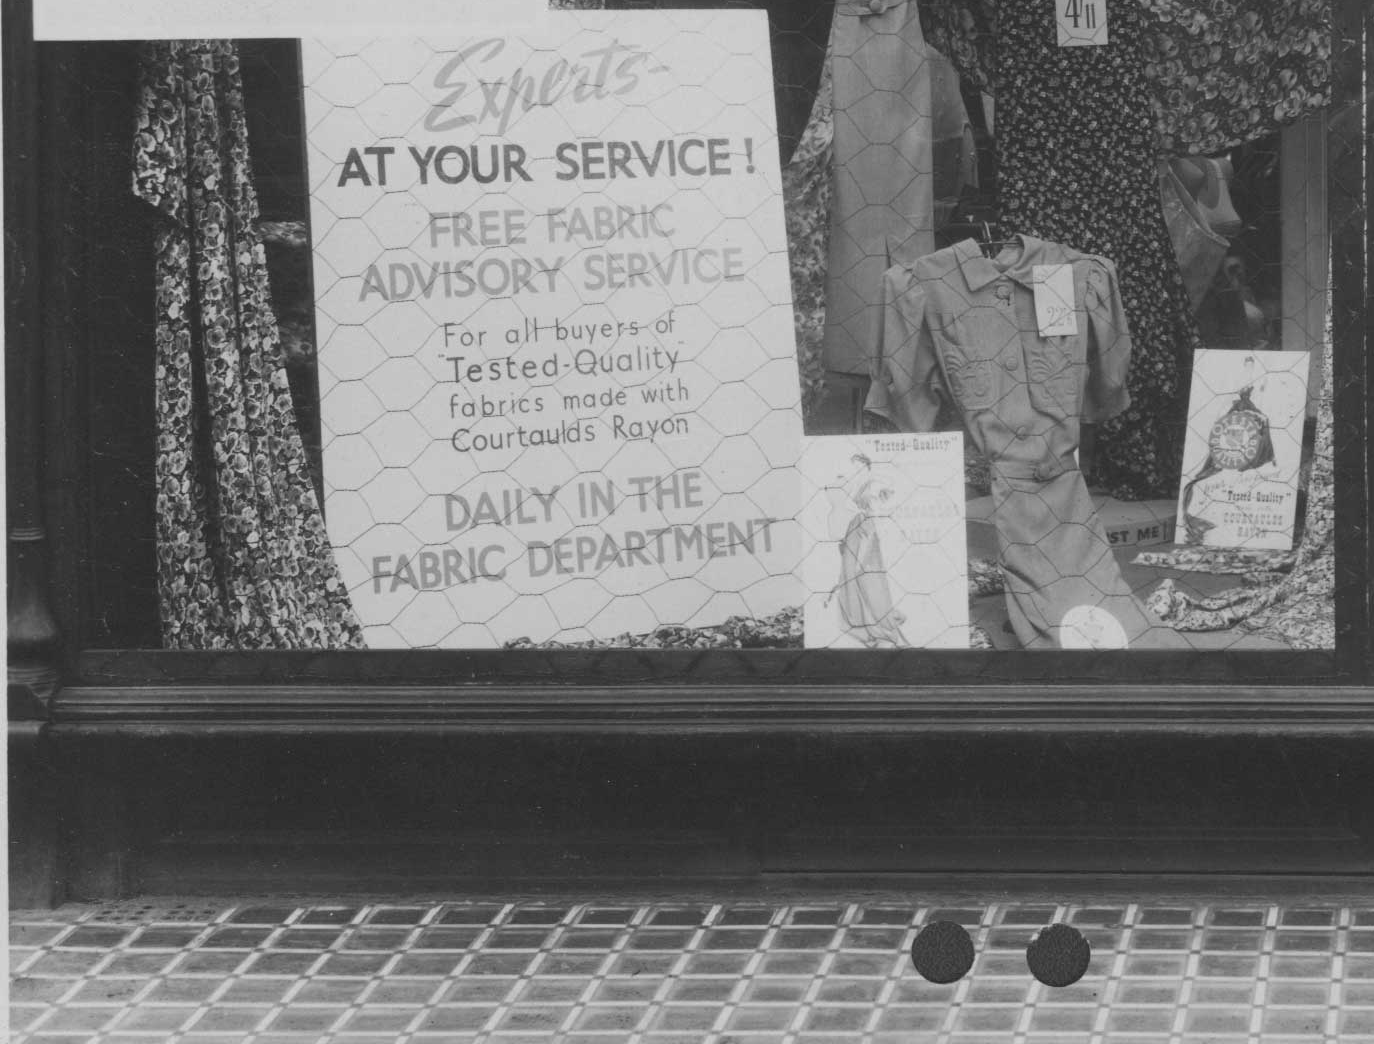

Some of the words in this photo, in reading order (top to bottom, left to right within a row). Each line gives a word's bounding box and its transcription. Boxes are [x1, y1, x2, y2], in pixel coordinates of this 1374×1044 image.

[336, 145, 396, 187] AT
[407, 143, 534, 185] YOUR
[428, 208, 528, 249] FREE
[545, 203, 677, 244] FABRIC
[357, 255, 566, 303] ADVISORY
[583, 246, 746, 292] SERVICE
[443, 322, 488, 348] For
[504, 318, 539, 345] all
[555, 317, 640, 345] buyers
[655, 309, 677, 335] of
[449, 392, 545, 420] fabrics
[562, 386, 628, 412] made
[641, 377, 690, 404] with
[450, 419, 597, 453] Courtaulds
[612, 413, 690, 443] Rayon
[444, 483, 561, 533] DAILY
[577, 479, 616, 520] IN
[627, 472, 705, 514] THE
[372, 544, 508, 595] FABRIC
[526, 517, 779, 578] DEPARTMENT
